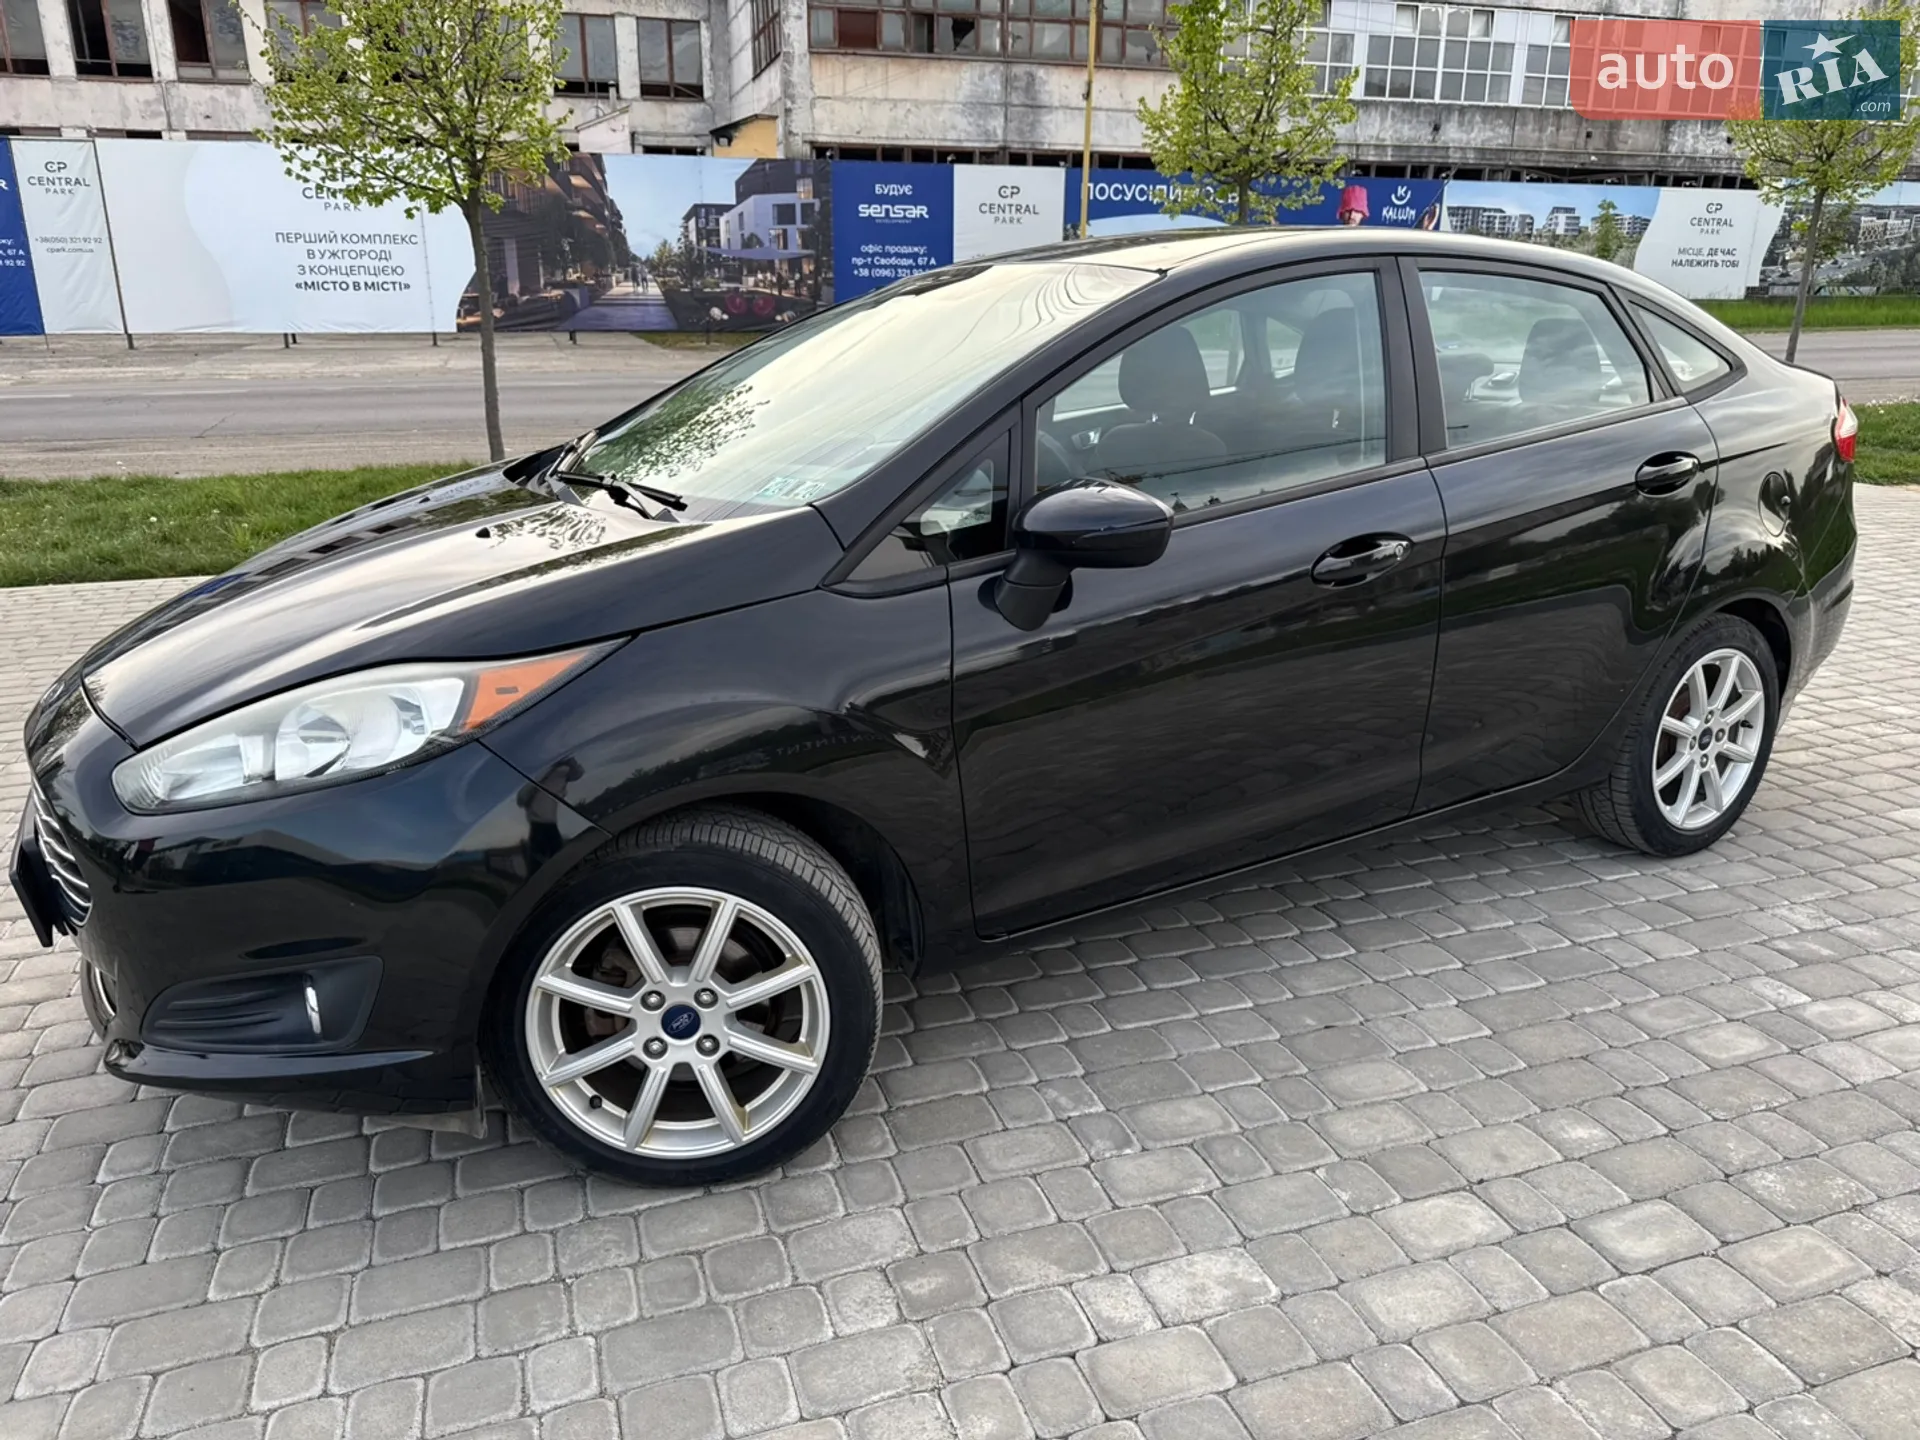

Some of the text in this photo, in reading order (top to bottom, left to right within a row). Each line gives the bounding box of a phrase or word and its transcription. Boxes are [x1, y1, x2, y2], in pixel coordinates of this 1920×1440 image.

[27, 176, 91, 187] CENTRAL
[874, 183, 913, 196] БУДУЄ
[978, 202, 1040, 215] CENTRAL
[993, 216, 1023, 225] PARK
[1690, 217, 1734, 227] CENTRAL
[275, 230, 419, 245] ПЕРШИЙ КОМПЛЕКС
[860, 244, 928, 255] офіс продажу:
[1677, 247, 1737, 257] МІСЦЕ, ДЕ ЧАС
[306, 249, 392, 262] В УЖГОРОДІ
[851, 257, 872, 266] пр-т
[873, 256, 916, 267] Свободи,
[917, 257, 928, 265] 67
[1670, 259, 1740, 268] НАЛЕЖИТЬ ТОБІ
[297, 264, 405, 277] З КОНЦЕПЦІЄЮ
[853, 268, 869, 277] +38
[871, 268, 895, 278] (096)
[294, 281, 411, 292] «МІСТО В МІСТІ»
